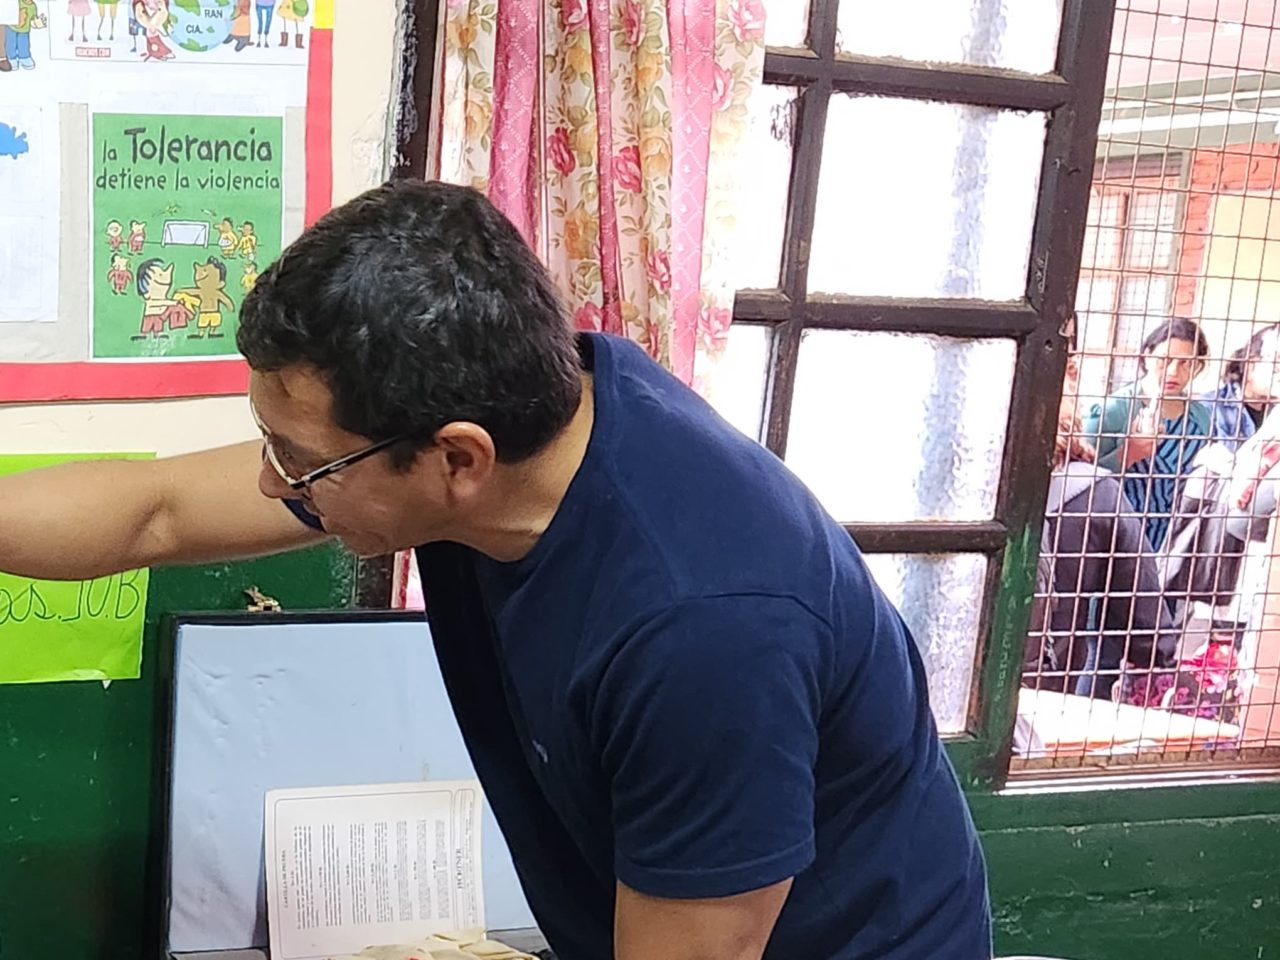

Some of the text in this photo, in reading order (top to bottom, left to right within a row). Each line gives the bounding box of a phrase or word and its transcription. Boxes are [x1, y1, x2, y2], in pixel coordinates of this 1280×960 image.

[204, 9, 223, 19] RAN
[102, 125, 272, 165] la Tolerancia
[96, 168, 281, 191] detiene la violencia
